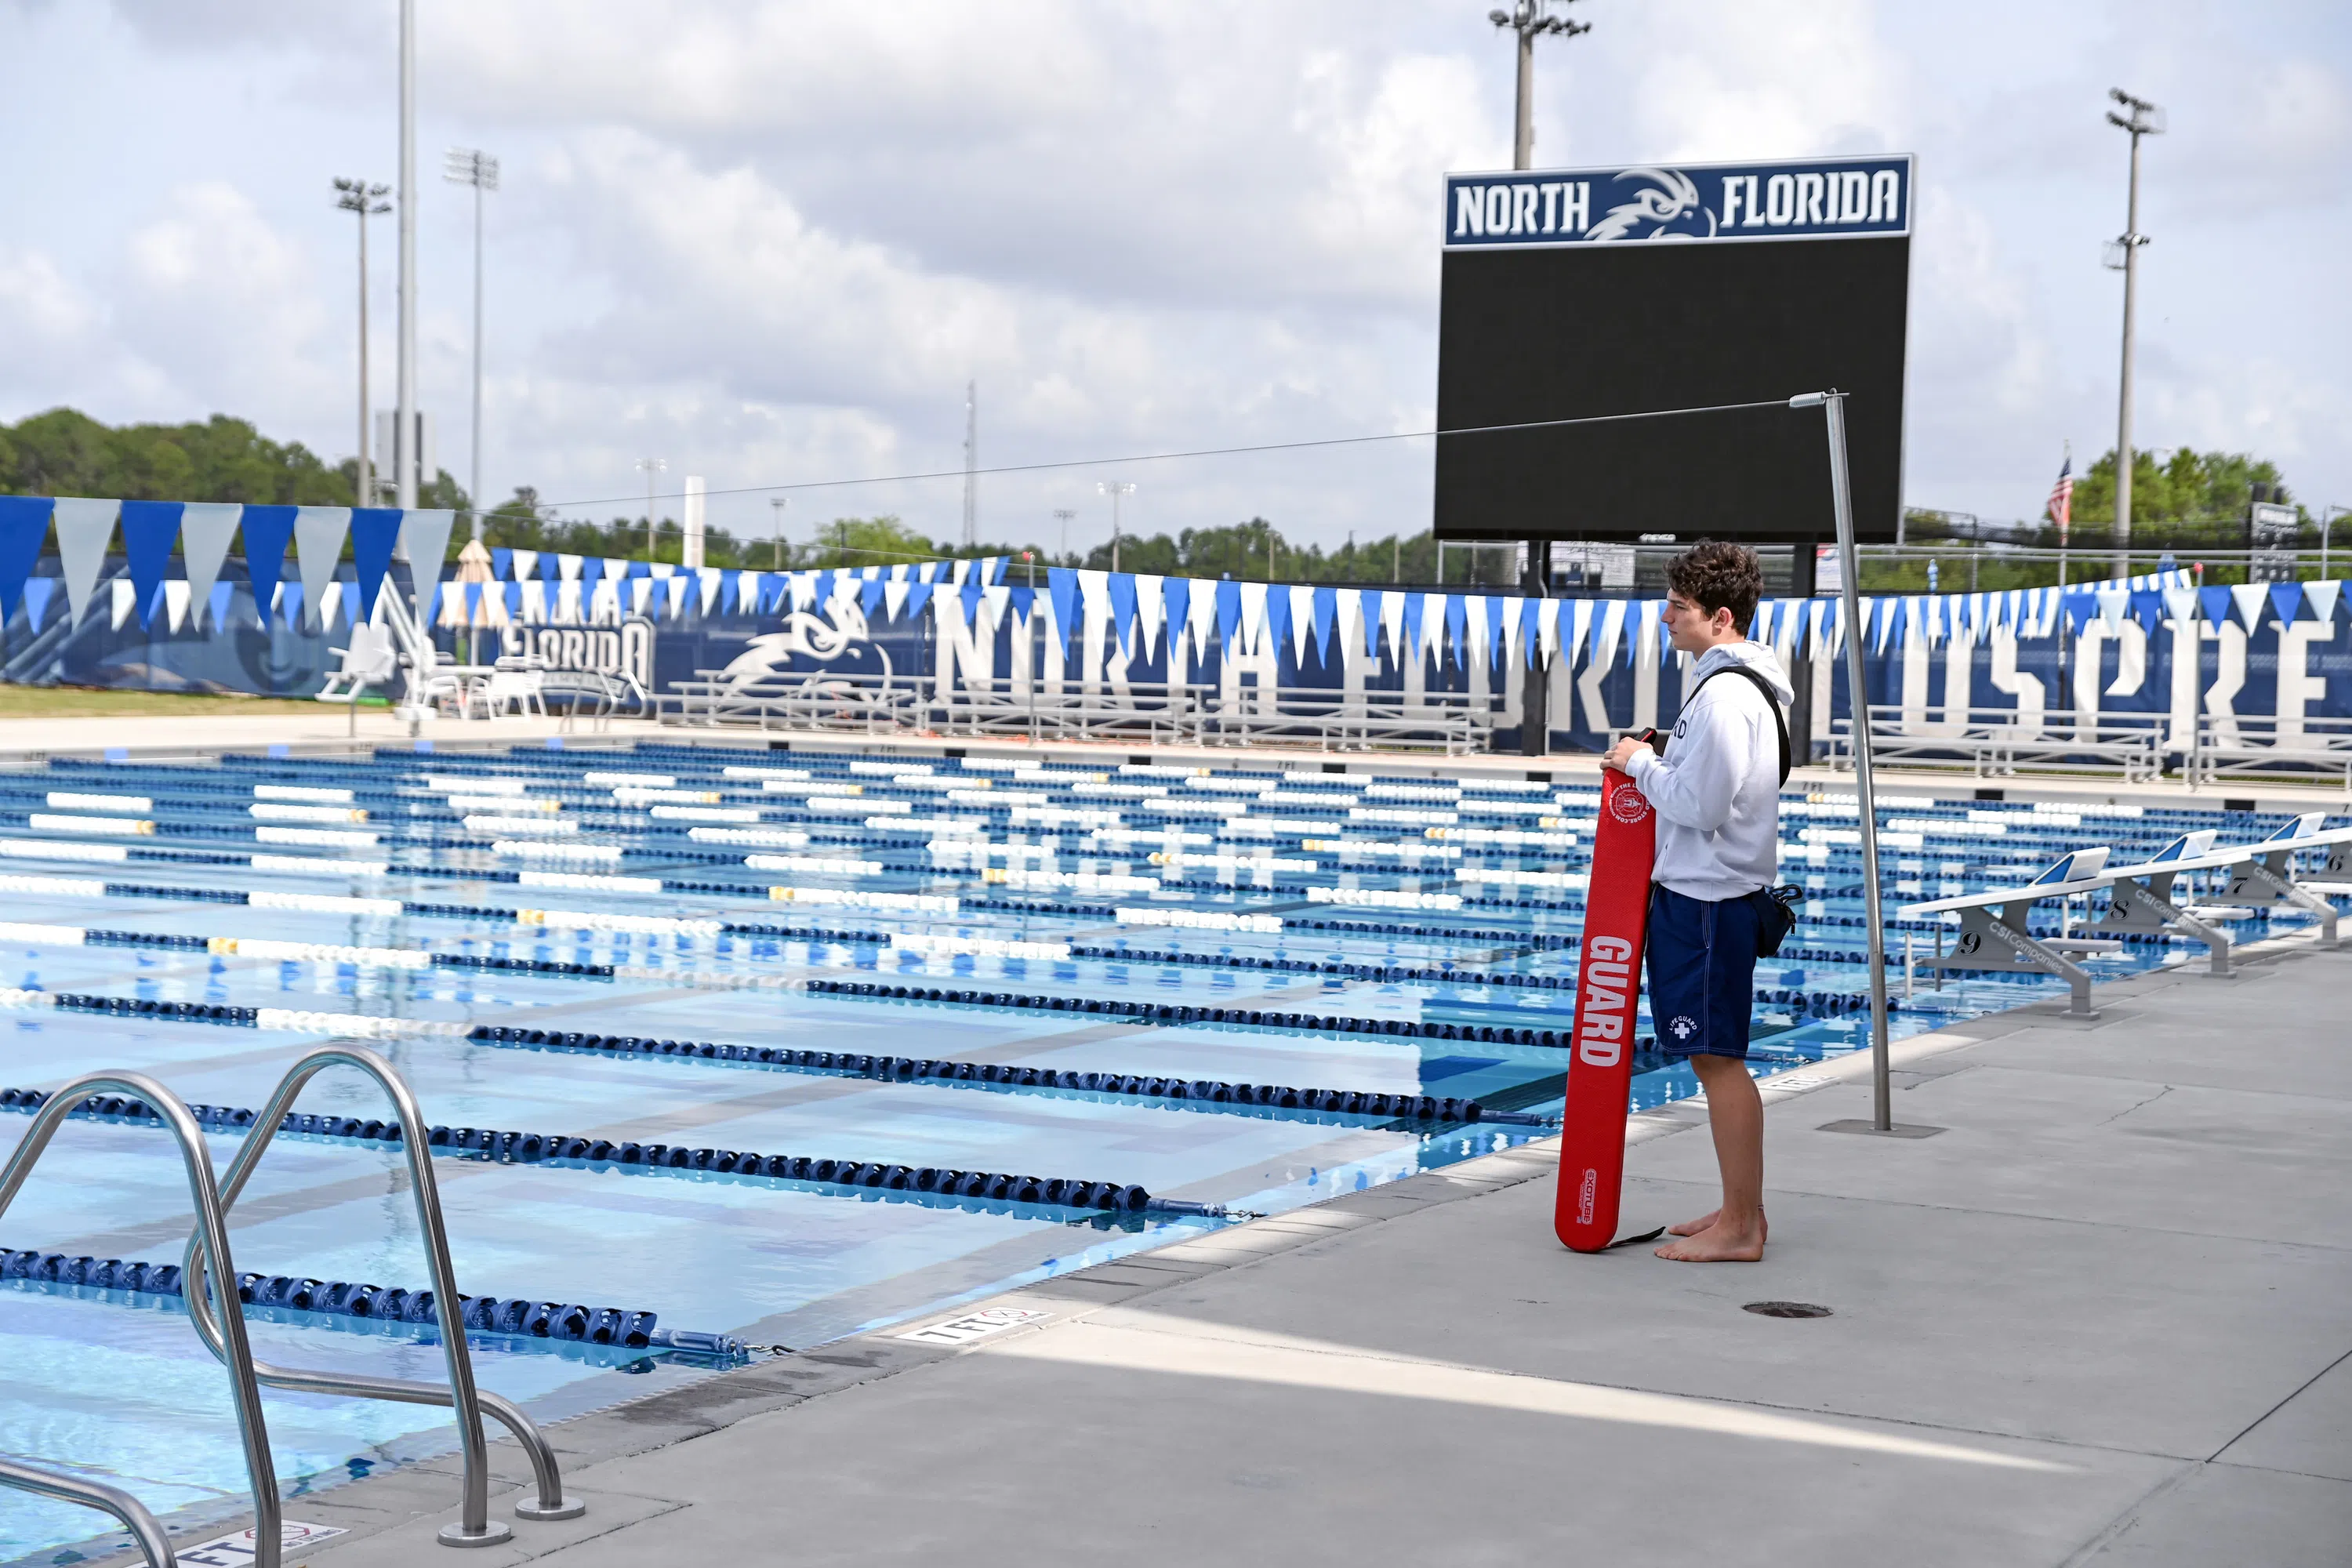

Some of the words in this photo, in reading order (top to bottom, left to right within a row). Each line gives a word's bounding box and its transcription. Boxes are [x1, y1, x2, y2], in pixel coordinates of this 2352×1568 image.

[1454, 181, 1590, 237] NORTH
[1719, 169, 1899, 228] FLORIDA
[2328, 855, 2346, 872] 6
[2234, 876, 2250, 895] 7
[2110, 898, 2130, 920] 8
[1958, 931, 1982, 956] 9
[1579, 935, 1632, 1067] GUARD
[1668, 1015, 1697, 1032] LIFEGUARD
[1583, 1171, 1595, 1223] EXOTUBE
[916, 1330, 962, 1339] 7
